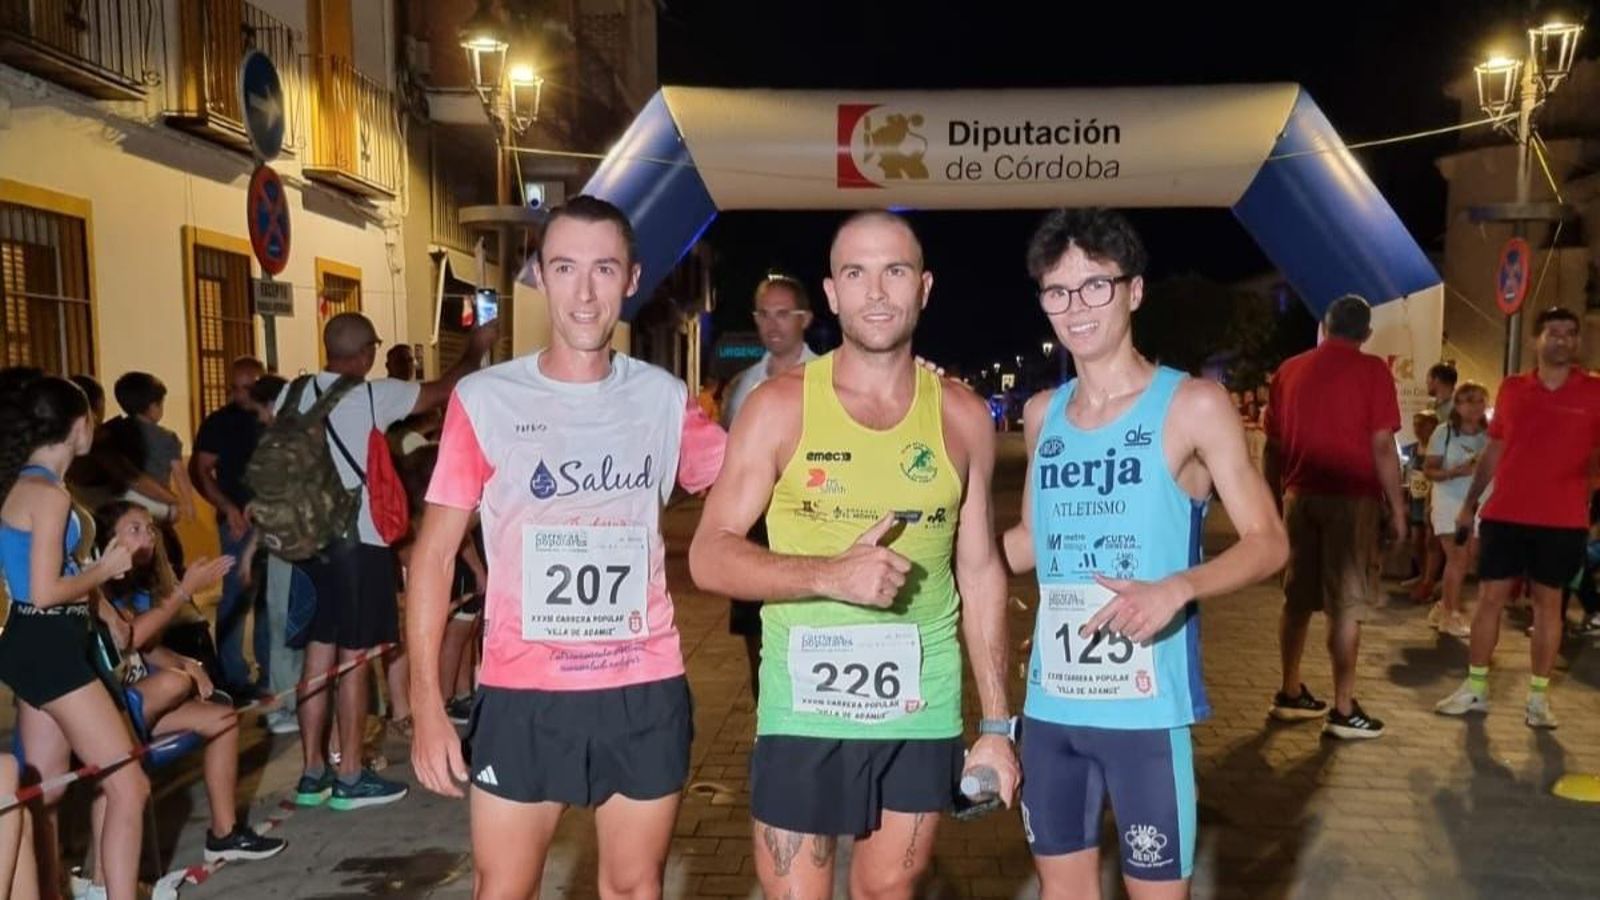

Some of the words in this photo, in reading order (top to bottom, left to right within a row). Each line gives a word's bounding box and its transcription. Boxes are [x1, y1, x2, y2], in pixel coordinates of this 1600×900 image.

[948, 118, 1121, 152] Diputación
[945, 156, 982, 181] de
[994, 154, 1120, 181] Córdoba
[1124, 424, 1153, 447] als
[556, 454, 653, 497] Salud
[1040, 447, 1143, 496] nerja
[1053, 500, 1126, 517] ATLETISMO
[1105, 534, 1136, 543] CUEVA
[545, 563, 631, 606] 207
[555, 614, 591, 624] CARRERA
[592, 614, 625, 624] POPULAR
[570, 627, 581, 636] DE
[1055, 622, 1135, 665] 125
[811, 661, 901, 700] 226
[1063, 672, 1094, 682] CARRERA
[1095, 673, 1129, 682] POPULAR
[1076, 686, 1086, 695] DE
[826, 699, 862, 709] CARRERA
[864, 700, 899, 708] POPULAR
[842, 710, 851, 718] DE
